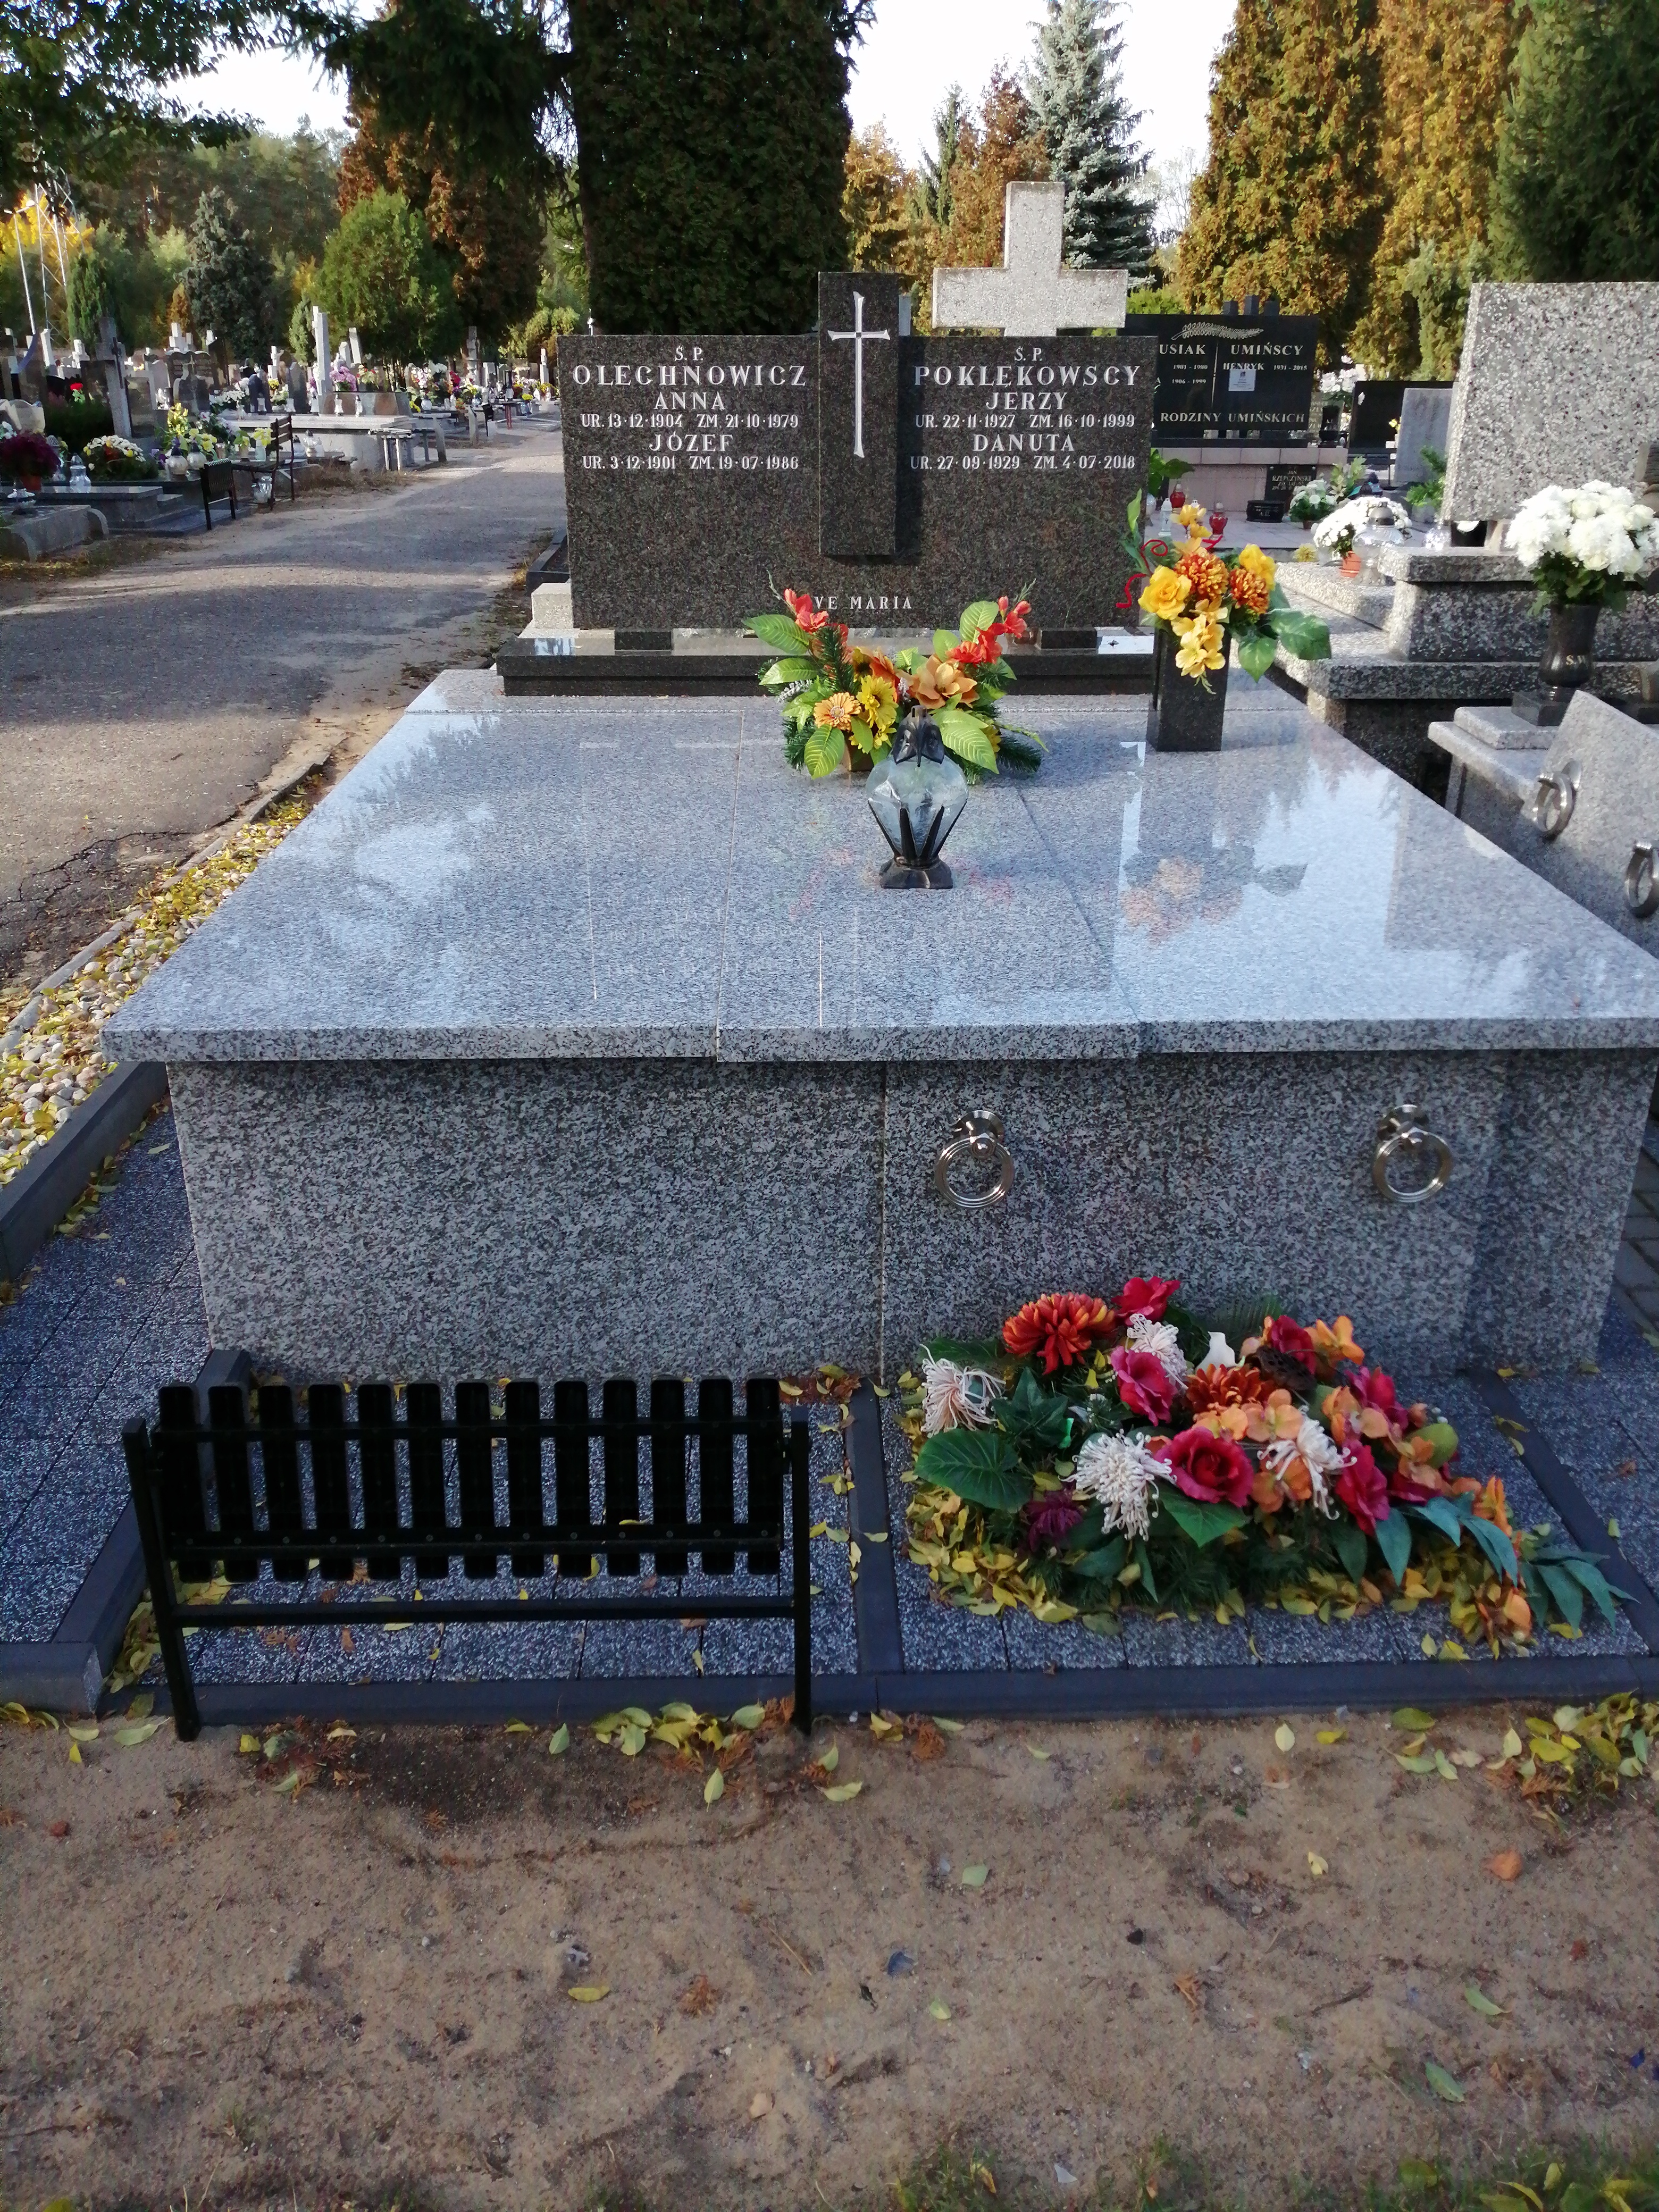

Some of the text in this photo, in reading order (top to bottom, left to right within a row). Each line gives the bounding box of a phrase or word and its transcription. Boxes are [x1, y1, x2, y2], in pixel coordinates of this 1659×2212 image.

[692, 347, 703, 361] P.
[1032, 347, 1042, 362] P.
[1231, 342, 1303, 355] UMIŃSCY
[572, 365, 806, 386] OLECHNOWICZ
[914, 365, 1141, 388] POKLĘKOWSCY
[653, 391, 726, 410] ANNA
[985, 391, 1068, 410] JERZY
[580, 413, 605, 428] UR.
[696, 414, 722, 428] ZM.
[915, 414, 938, 429] UR.
[1029, 414, 1054, 429] ZM.
[1160, 410, 1305, 423] RODZINY UMIŃSKICH
[649, 430, 733, 452] JÓZEF
[973, 433, 1075, 452] DANUTA
[582, 455, 605, 470] UR.
[689, 456, 715, 470] ZM.
[910, 456, 932, 470] UR.
[1034, 455, 1058, 470] ZM.
[813, 596, 912, 609] VE MARIA
